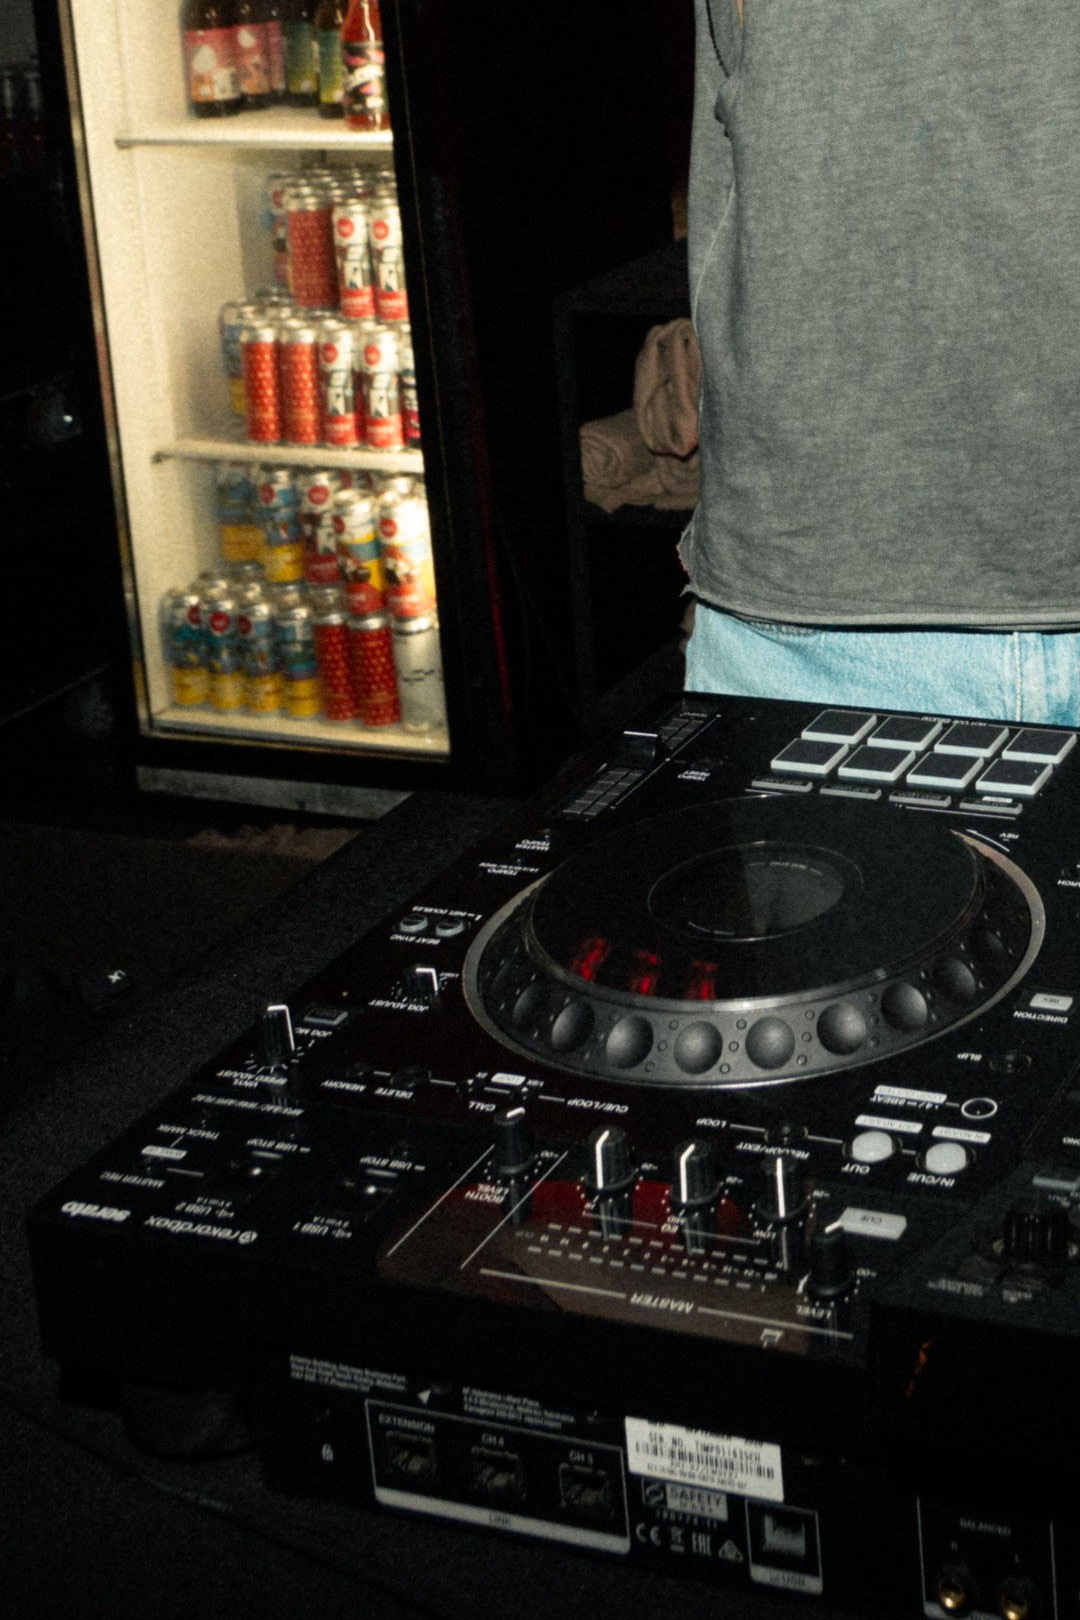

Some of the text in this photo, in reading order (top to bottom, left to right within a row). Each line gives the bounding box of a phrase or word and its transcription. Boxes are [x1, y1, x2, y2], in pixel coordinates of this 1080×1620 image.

[1013, 1011, 1068, 1024] DIRECTION
[321, 1080, 367, 1093] MEMORY
[374, 1086, 414, 1099] DELETE
[468, 1101, 496, 1112] CALL
[566, 1098, 630, 1114] CUE/LOOP
[695, 1116, 727, 1128] LOOP
[359, 1155, 412, 1170] USB STOP
[841, 1162, 870, 1175] OUT
[906, 1172, 955, 1187] IN/CUE
[476, 1181, 509, 1195] LEVEL
[464, 1190, 504, 1204] BOOTH
[61, 1201, 131, 1222] serato
[144, 1215, 240, 1241] rekordbox
[301, 1224, 329, 1236] USB
[660, 1223, 679, 1233] EQ
[630, 1291, 694, 1313] MASTER
[795, 1303, 832, 1320] LEVEL
[378, 1413, 436, 1433] EXTENSION
[481, 1433, 496, 1446] CH
[569, 1450, 586, 1462] CH
[670, 1487, 721, 1508] SAFETY
